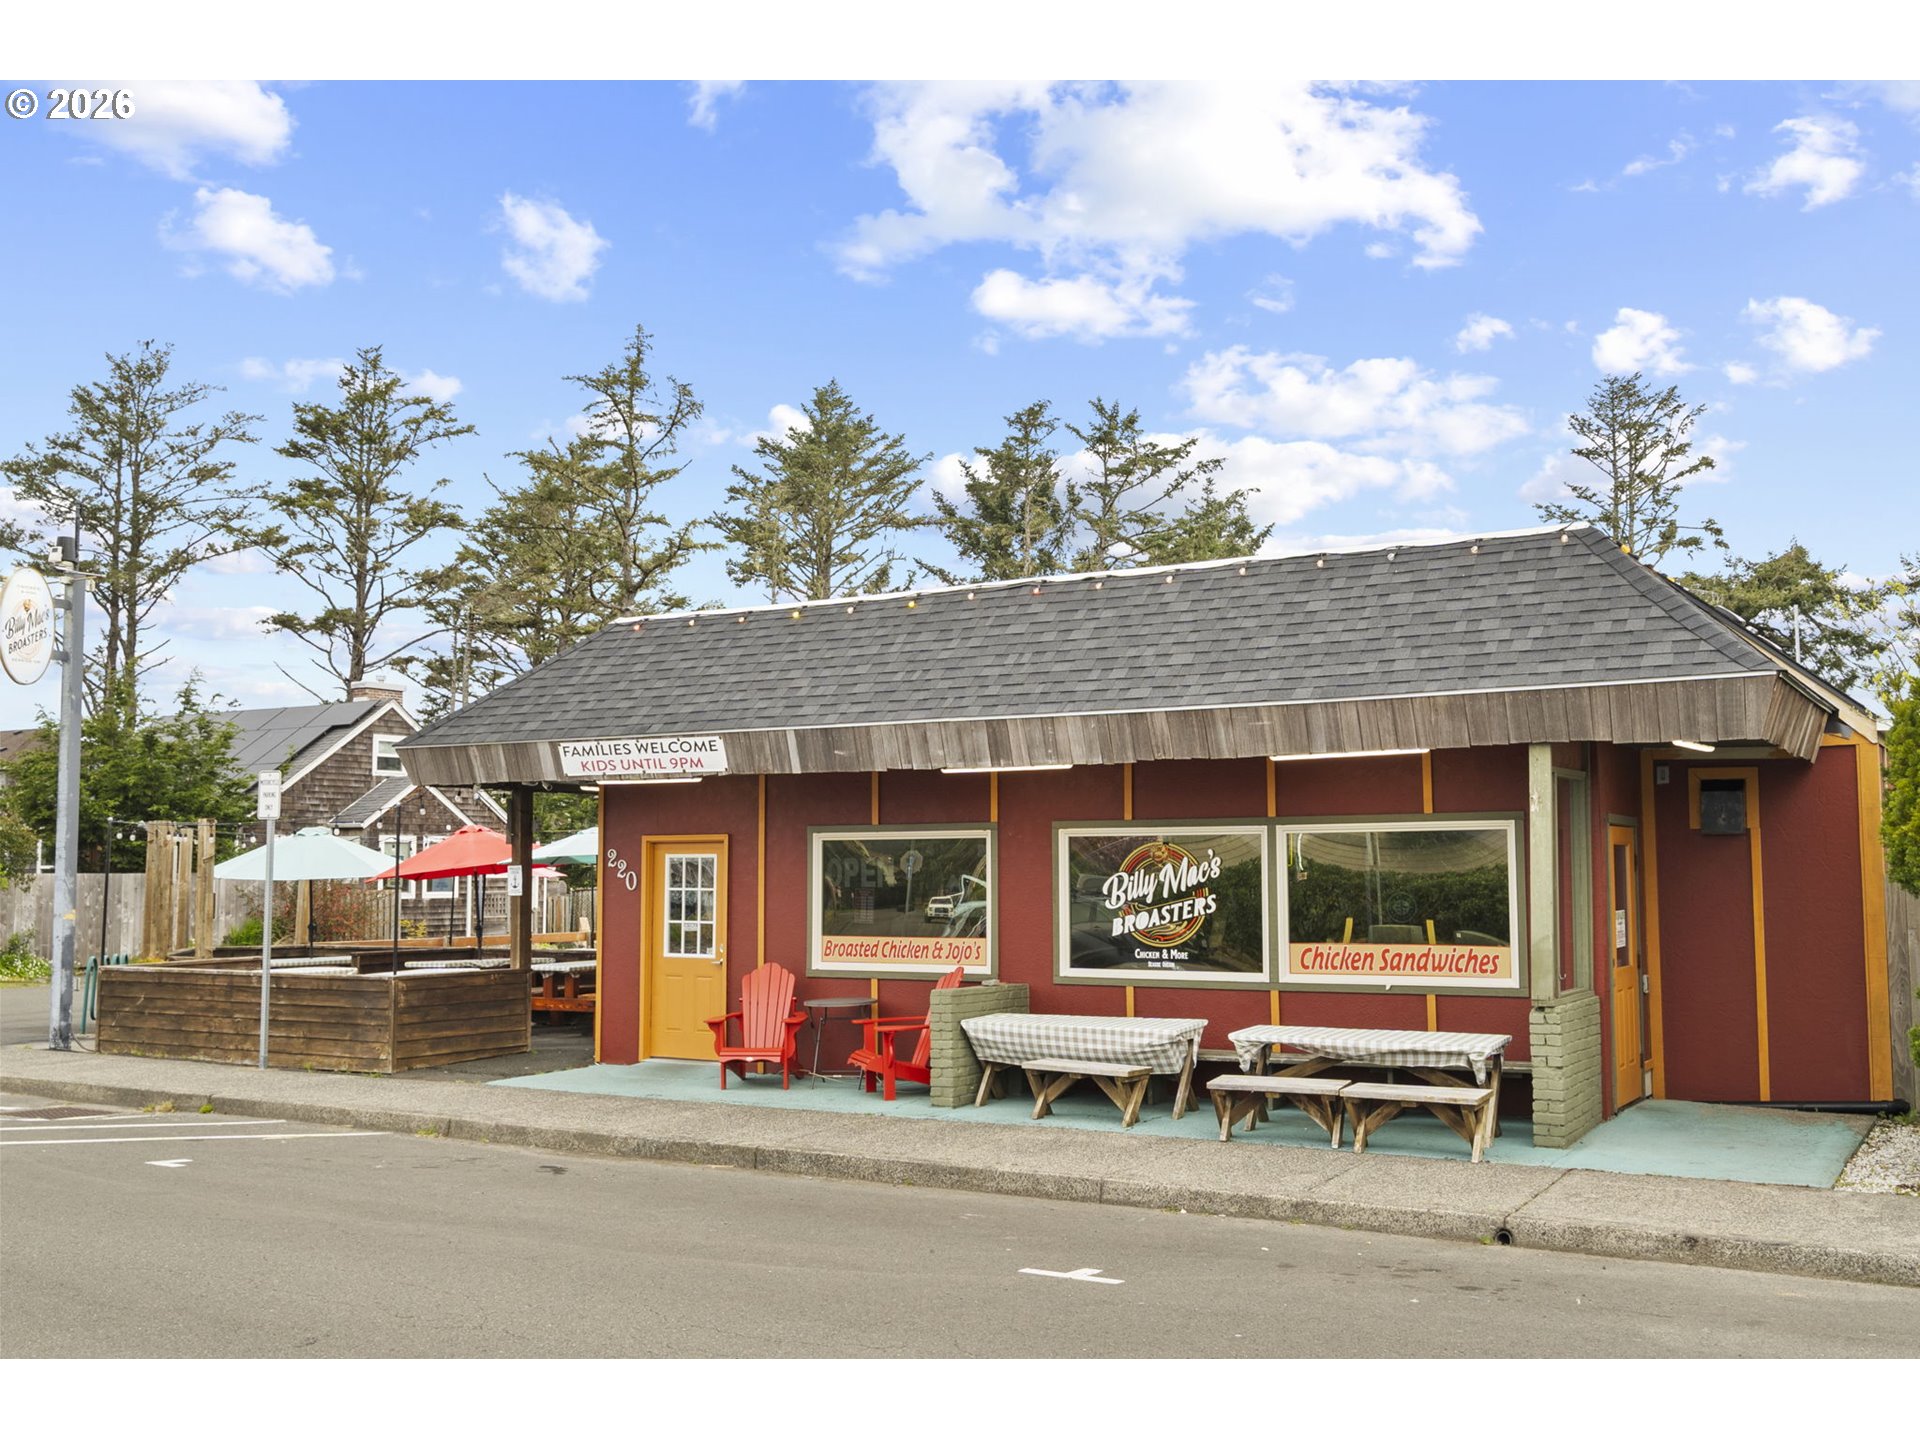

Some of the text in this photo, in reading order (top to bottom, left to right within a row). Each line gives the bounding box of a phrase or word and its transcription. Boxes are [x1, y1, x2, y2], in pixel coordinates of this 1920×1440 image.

[8, 628, 48, 654] BROASTERS
[563, 740, 718, 757] FAMILIES WELCOME
[581, 757, 704, 772] KIDS UNTIL 9PM
[607, 848, 638, 891] 220
[1102, 849, 1221, 909] Billy Mac's
[1112, 894, 1216, 937] BROASTERS
[824, 940, 981, 964] Broasted Chicken & Jojo's
[1162, 949, 1169, 959] &
[1300, 946, 1500, 975] Chicken Sandwiches
